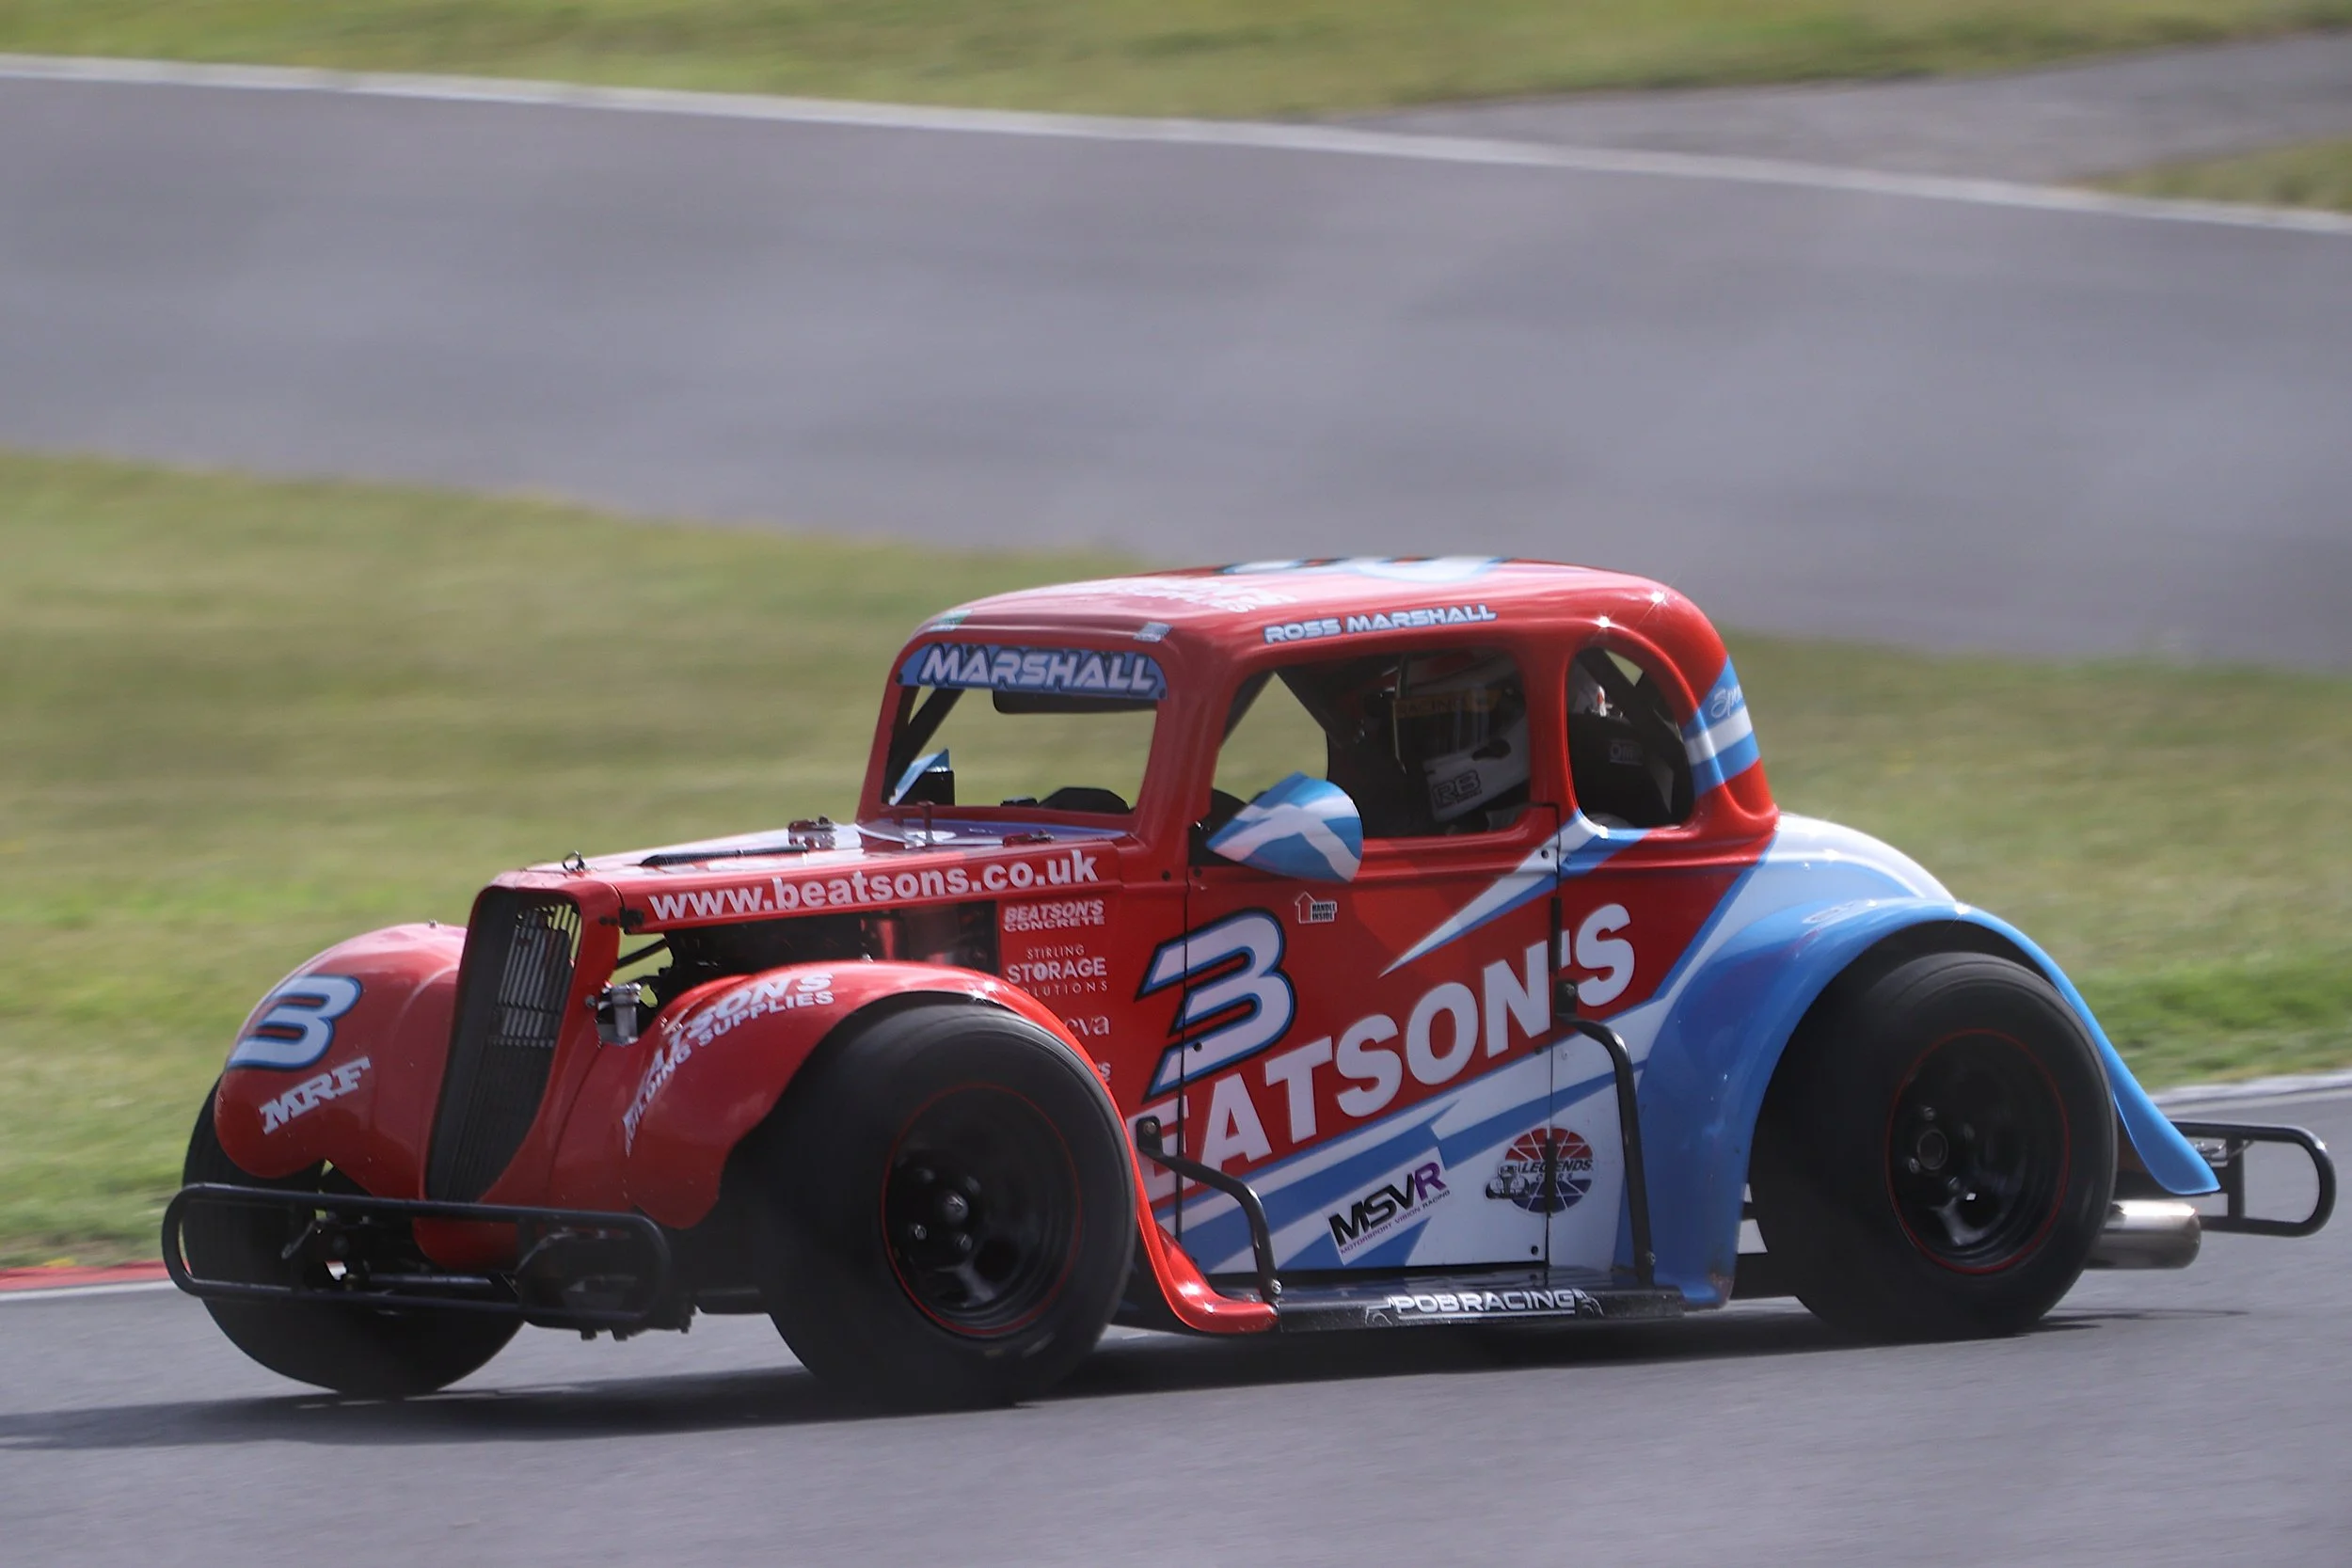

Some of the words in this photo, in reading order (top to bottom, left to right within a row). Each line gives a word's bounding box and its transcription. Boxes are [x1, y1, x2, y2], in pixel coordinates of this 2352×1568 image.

[1264, 617, 1342, 645] ROSS
[1346, 604, 1498, 633] MARSHALL
[918, 645, 1157, 691] MARSHALL
[648, 849, 1099, 921] www.beatsons.co.uk
[1004, 899, 1105, 924] BEATSON'S
[1004, 915, 1105, 932] CONCRETE
[1007, 957, 1107, 985] STORAGE
[1026, 944, 1085, 960] STIRLING
[1023, 980, 1108, 998] LUTIONS
[1134, 907, 1297, 1105] 3
[228, 974, 363, 1072] 3
[696, 990, 835, 1048] SUPPLIES
[259, 1055, 372, 1136] MRF
[1328, 1162, 1447, 1247] MSVR
[1340, 1223, 1392, 1255] MOTORSPORT
[1422, 1190, 1451, 1210] RACING
